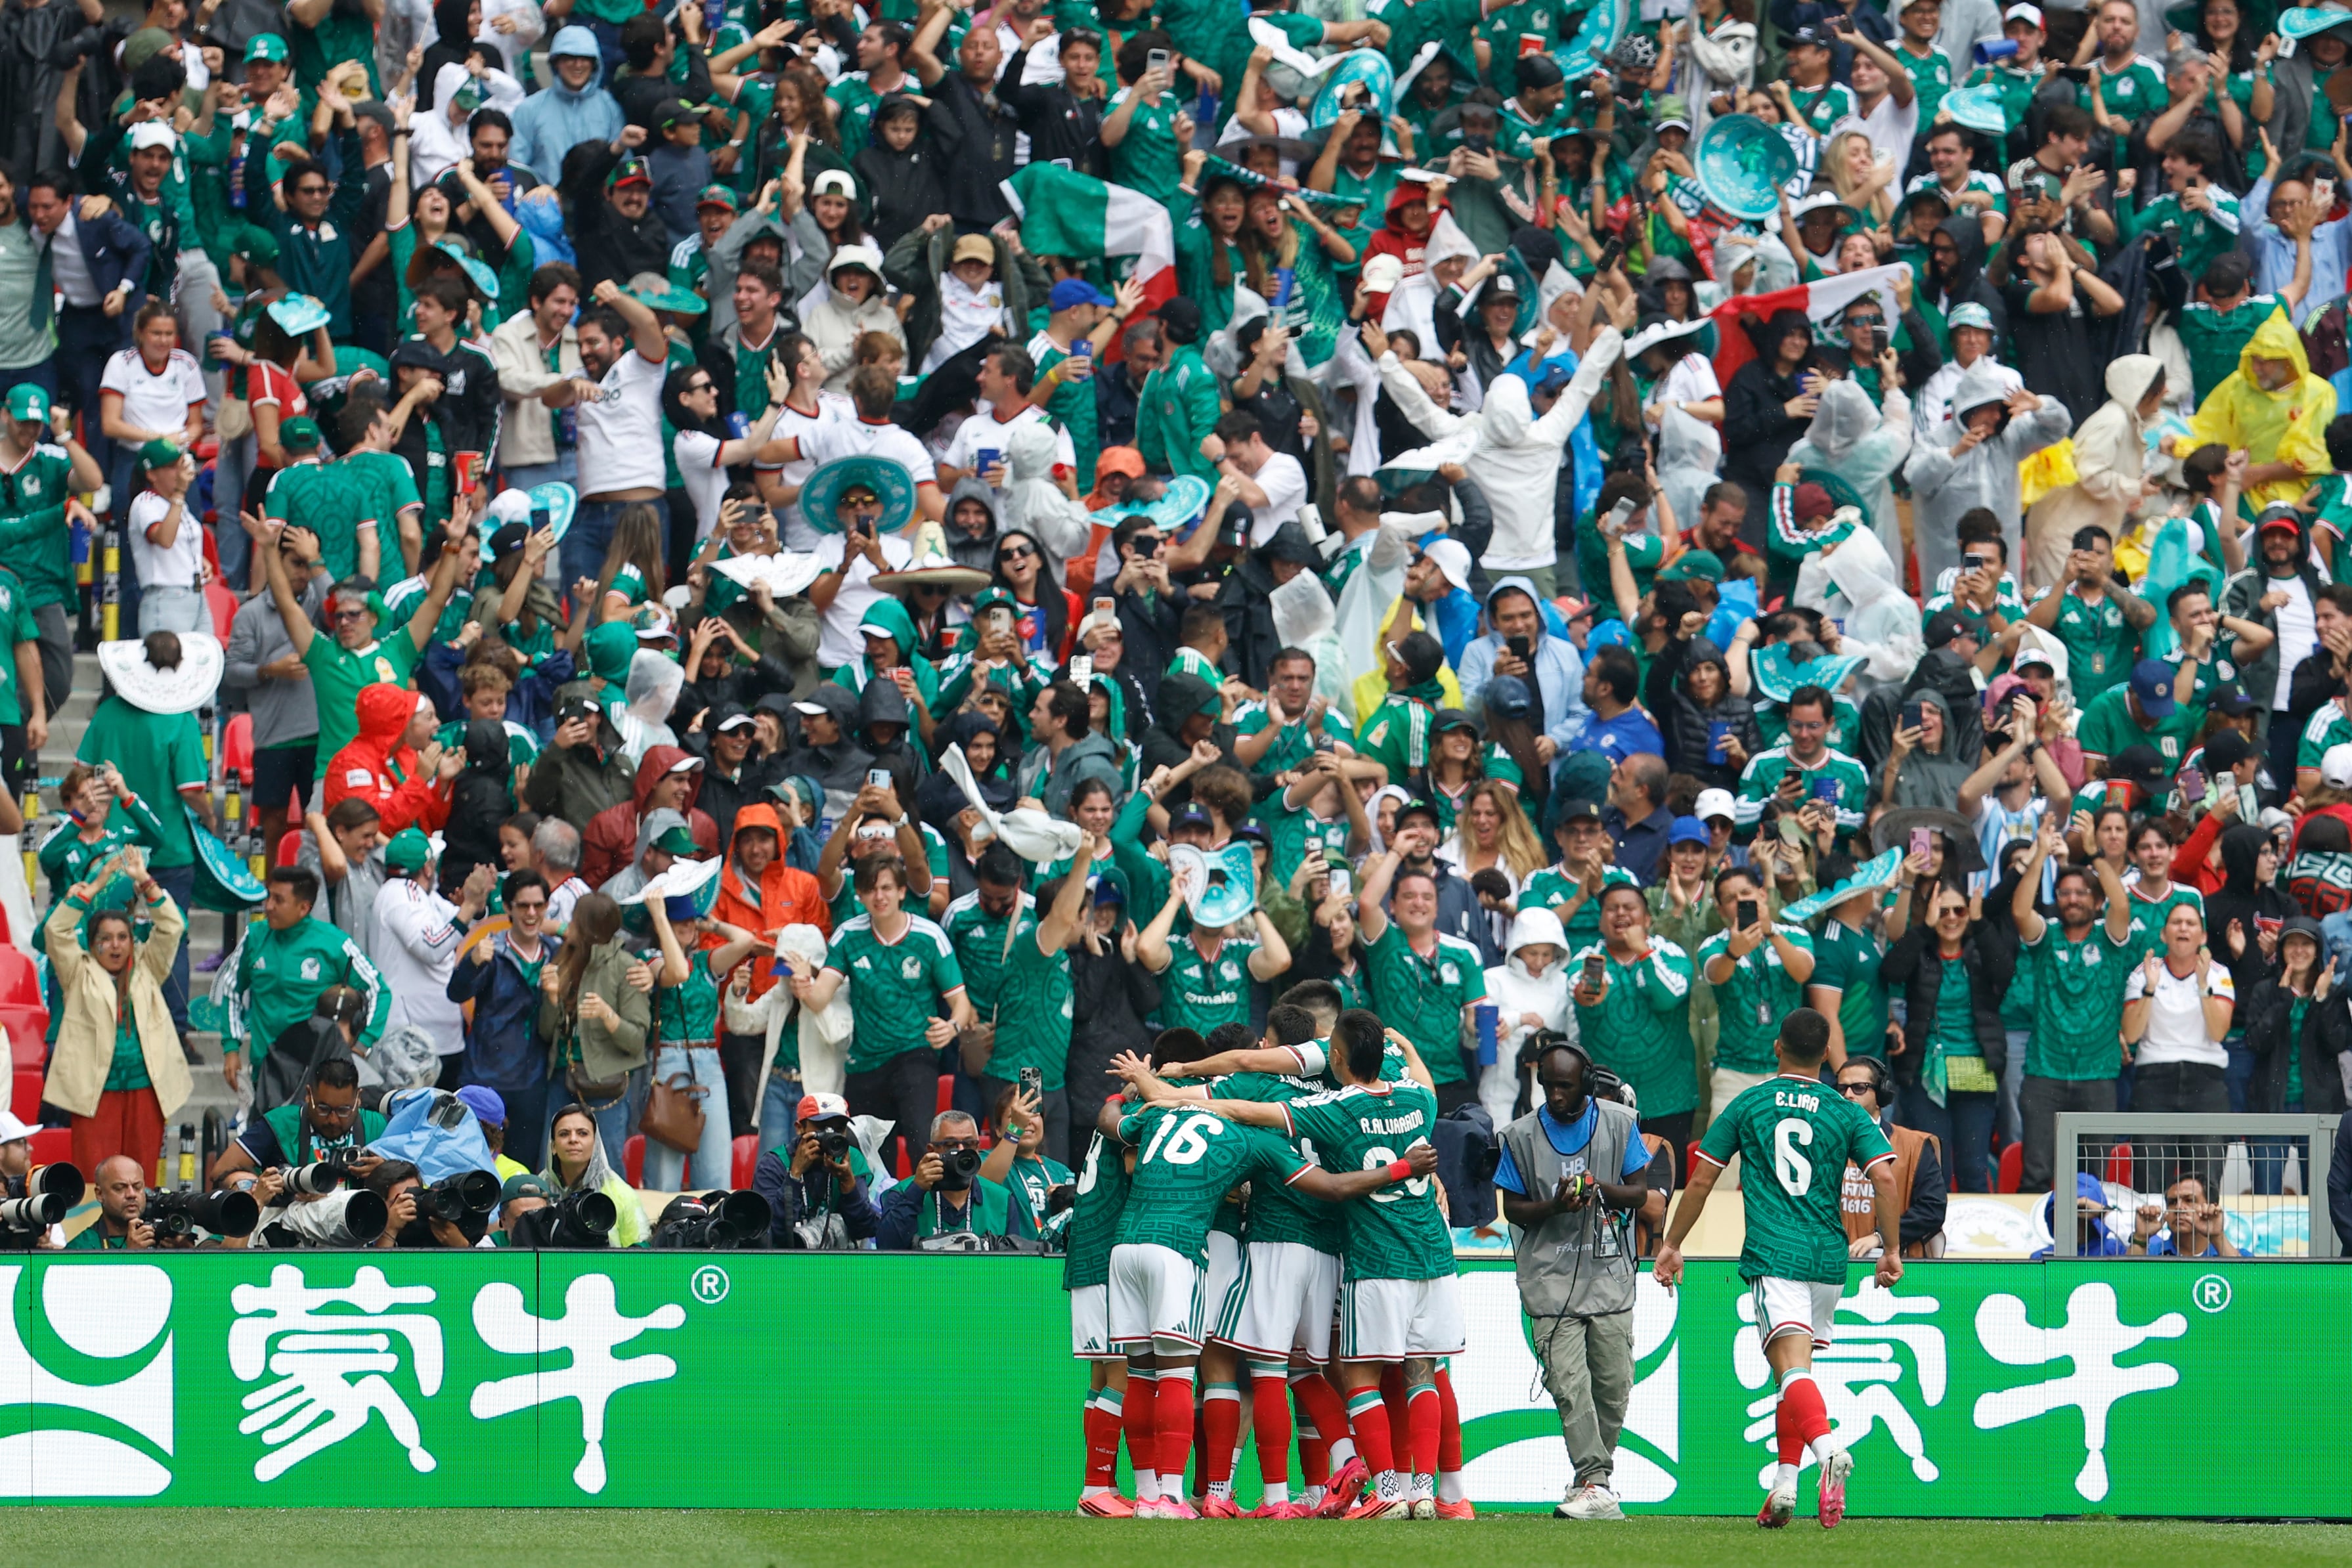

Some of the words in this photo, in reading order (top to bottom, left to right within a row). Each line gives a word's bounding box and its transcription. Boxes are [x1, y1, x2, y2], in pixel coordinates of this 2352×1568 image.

[1775, 1091, 1819, 1114] E.LIRA
[1143, 1114, 1224, 1165] 16
[1360, 1109, 1424, 1135] R.ALVARADO
[1561, 1157, 1586, 1179] HB
[1774, 1118, 1814, 1196] 6
[1840, 1198, 1871, 1214] 1616
[228, 1263, 687, 1494] 蒙牛
[1733, 1275, 2188, 1502] 蒙牛
